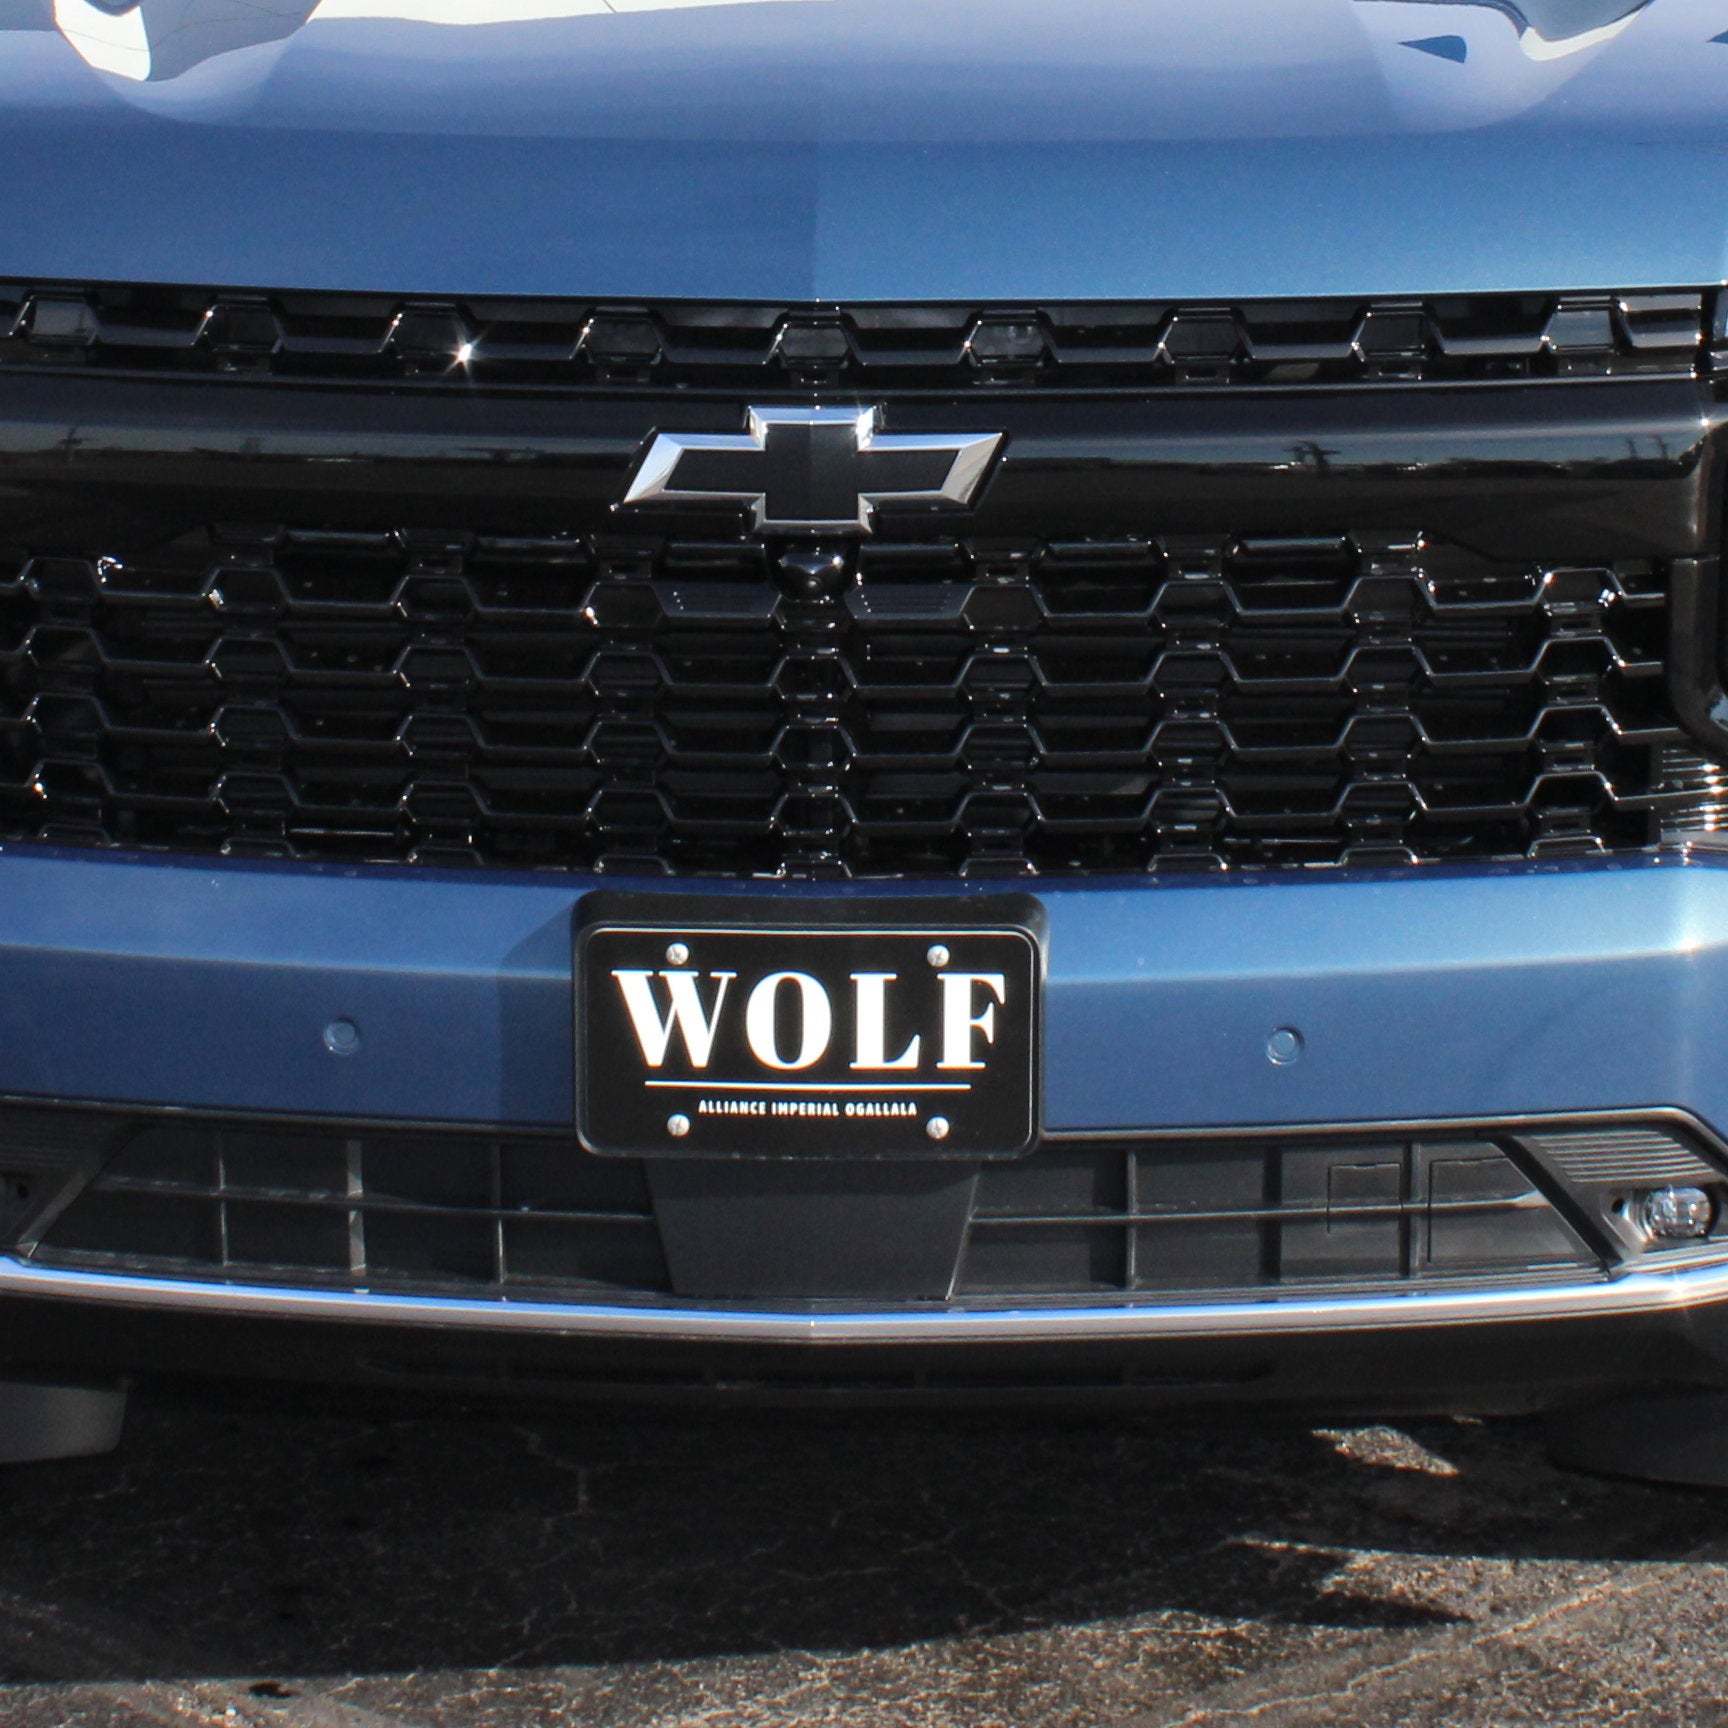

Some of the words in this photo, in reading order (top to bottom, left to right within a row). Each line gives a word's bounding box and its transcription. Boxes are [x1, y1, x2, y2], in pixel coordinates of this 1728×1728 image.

[611, 969, 1006, 1070] WOLF
[698, 1099, 767, 1115] ALLIANCE
[771, 1101, 840, 1116] IMPERIAL
[845, 1102, 918, 1117] OGALLALA
